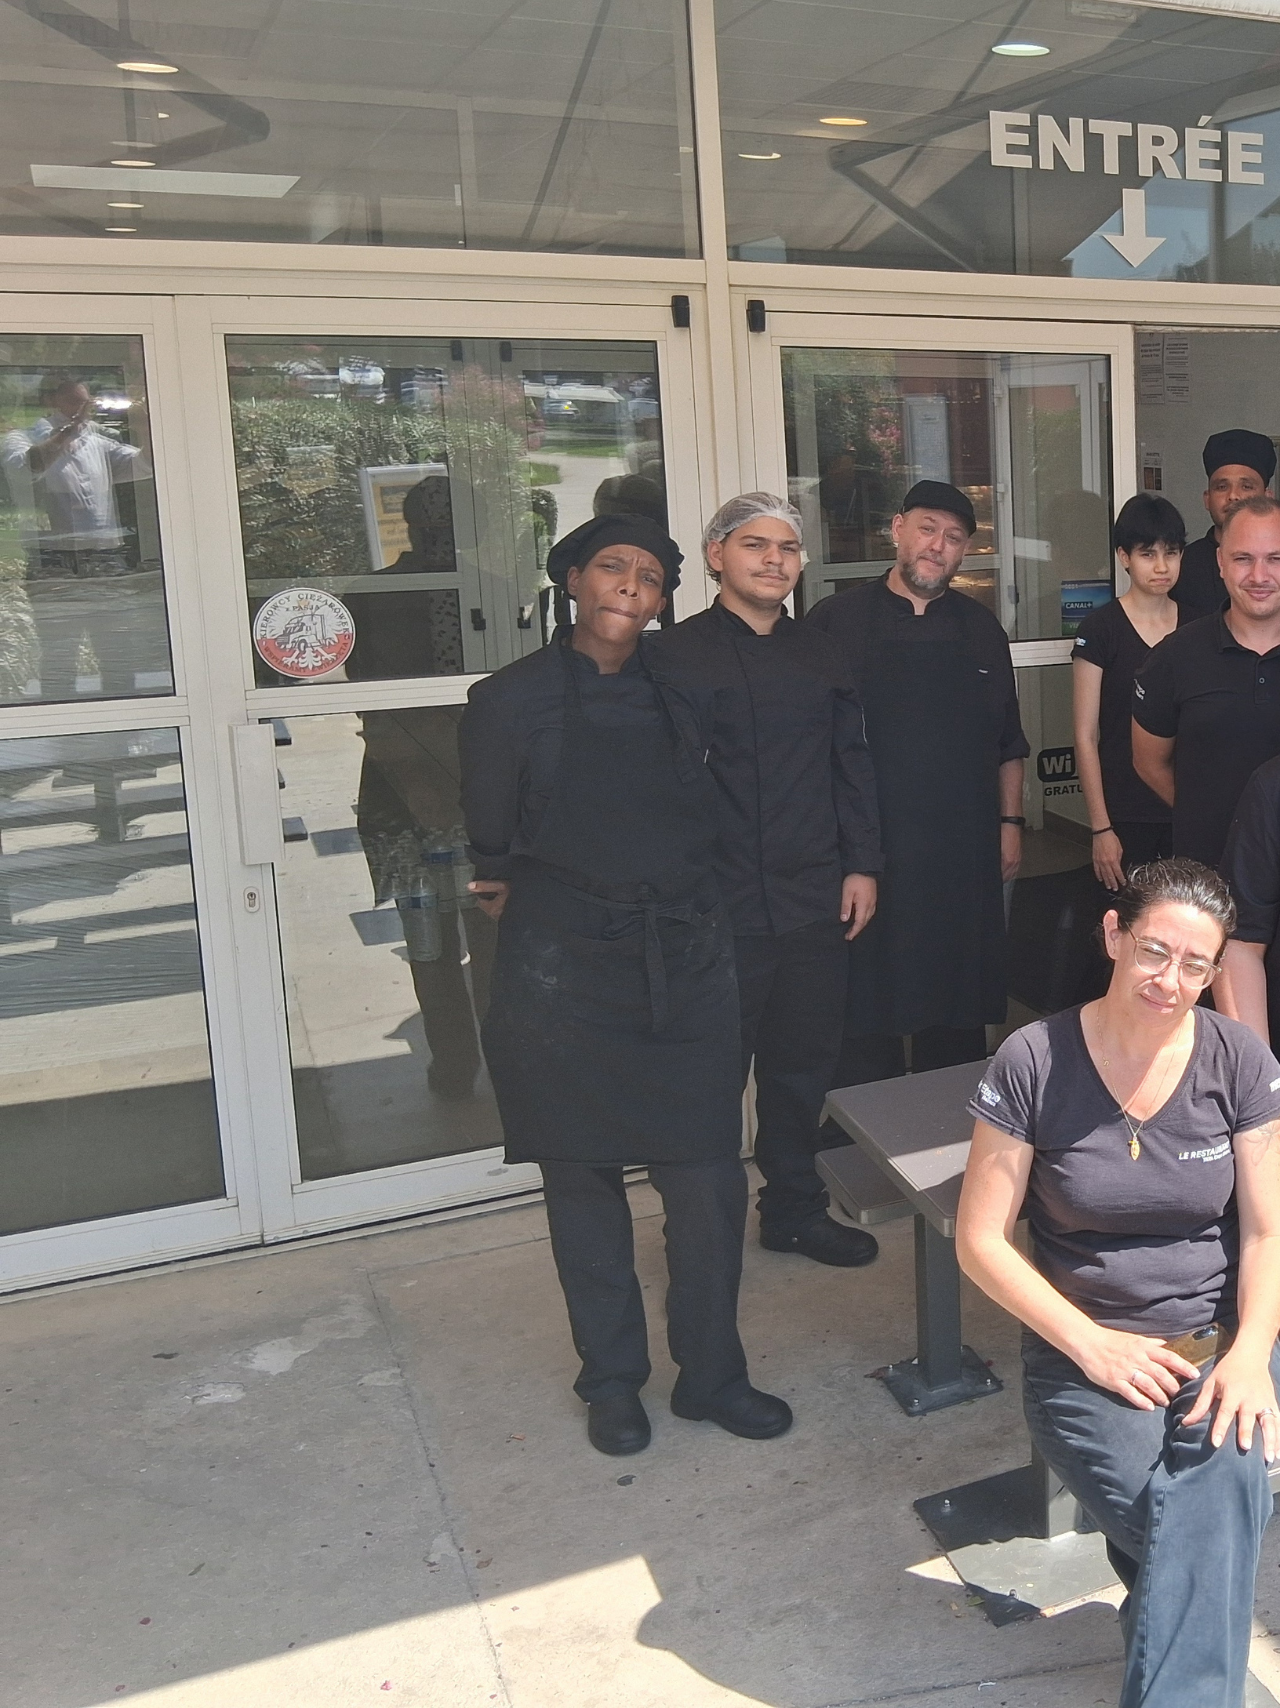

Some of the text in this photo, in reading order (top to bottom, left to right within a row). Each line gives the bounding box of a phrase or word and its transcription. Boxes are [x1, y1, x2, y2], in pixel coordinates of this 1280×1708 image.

[989, 110, 1265, 185] ENTRÉE
[260, 594, 291, 637] KIEROWCY
[1044, 784, 1083, 797] GRATU
[1178, 1152, 1189, 1160] LE
